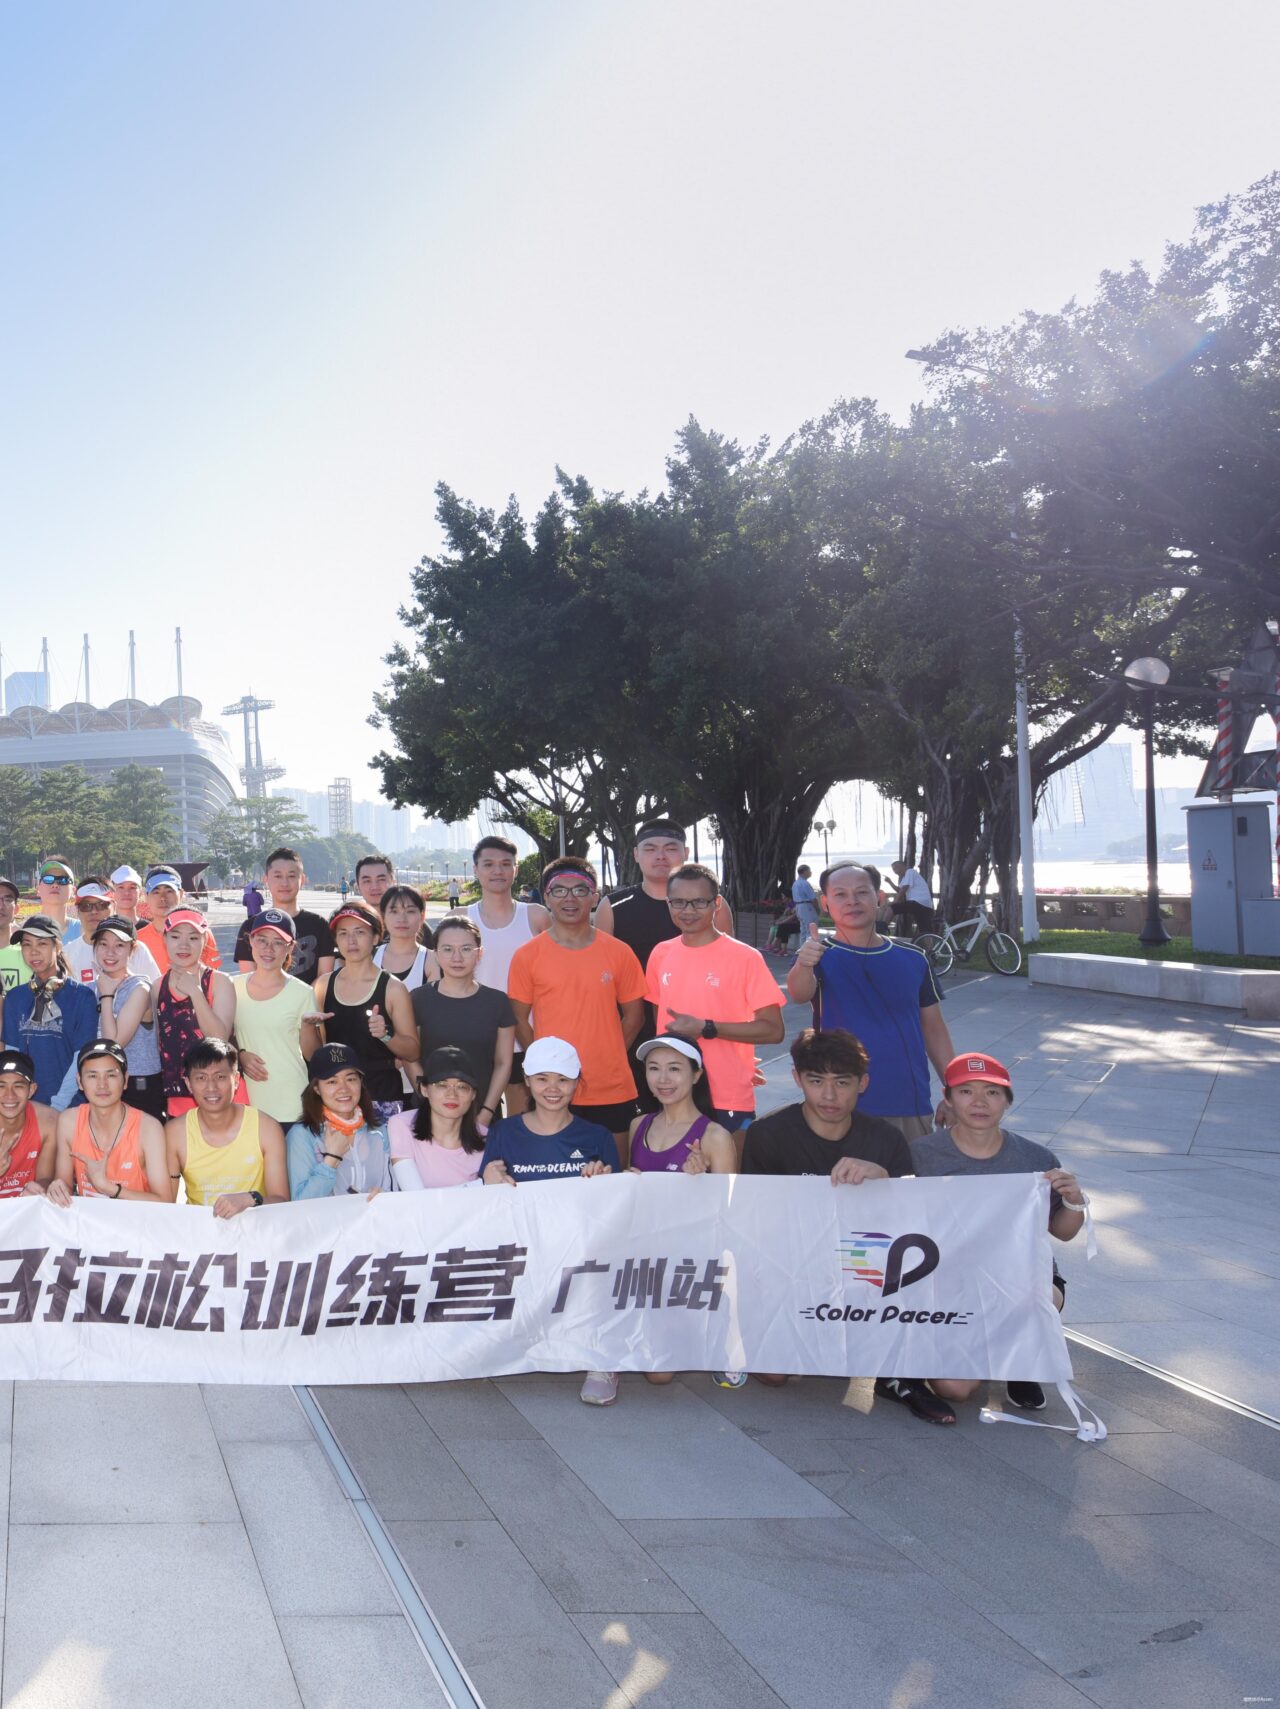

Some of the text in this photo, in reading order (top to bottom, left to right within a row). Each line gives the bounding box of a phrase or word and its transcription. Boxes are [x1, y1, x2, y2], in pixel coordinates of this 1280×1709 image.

[551, 1257, 729, 1314] 广州站
[815, 1303, 958, 1325] Color Pacer
